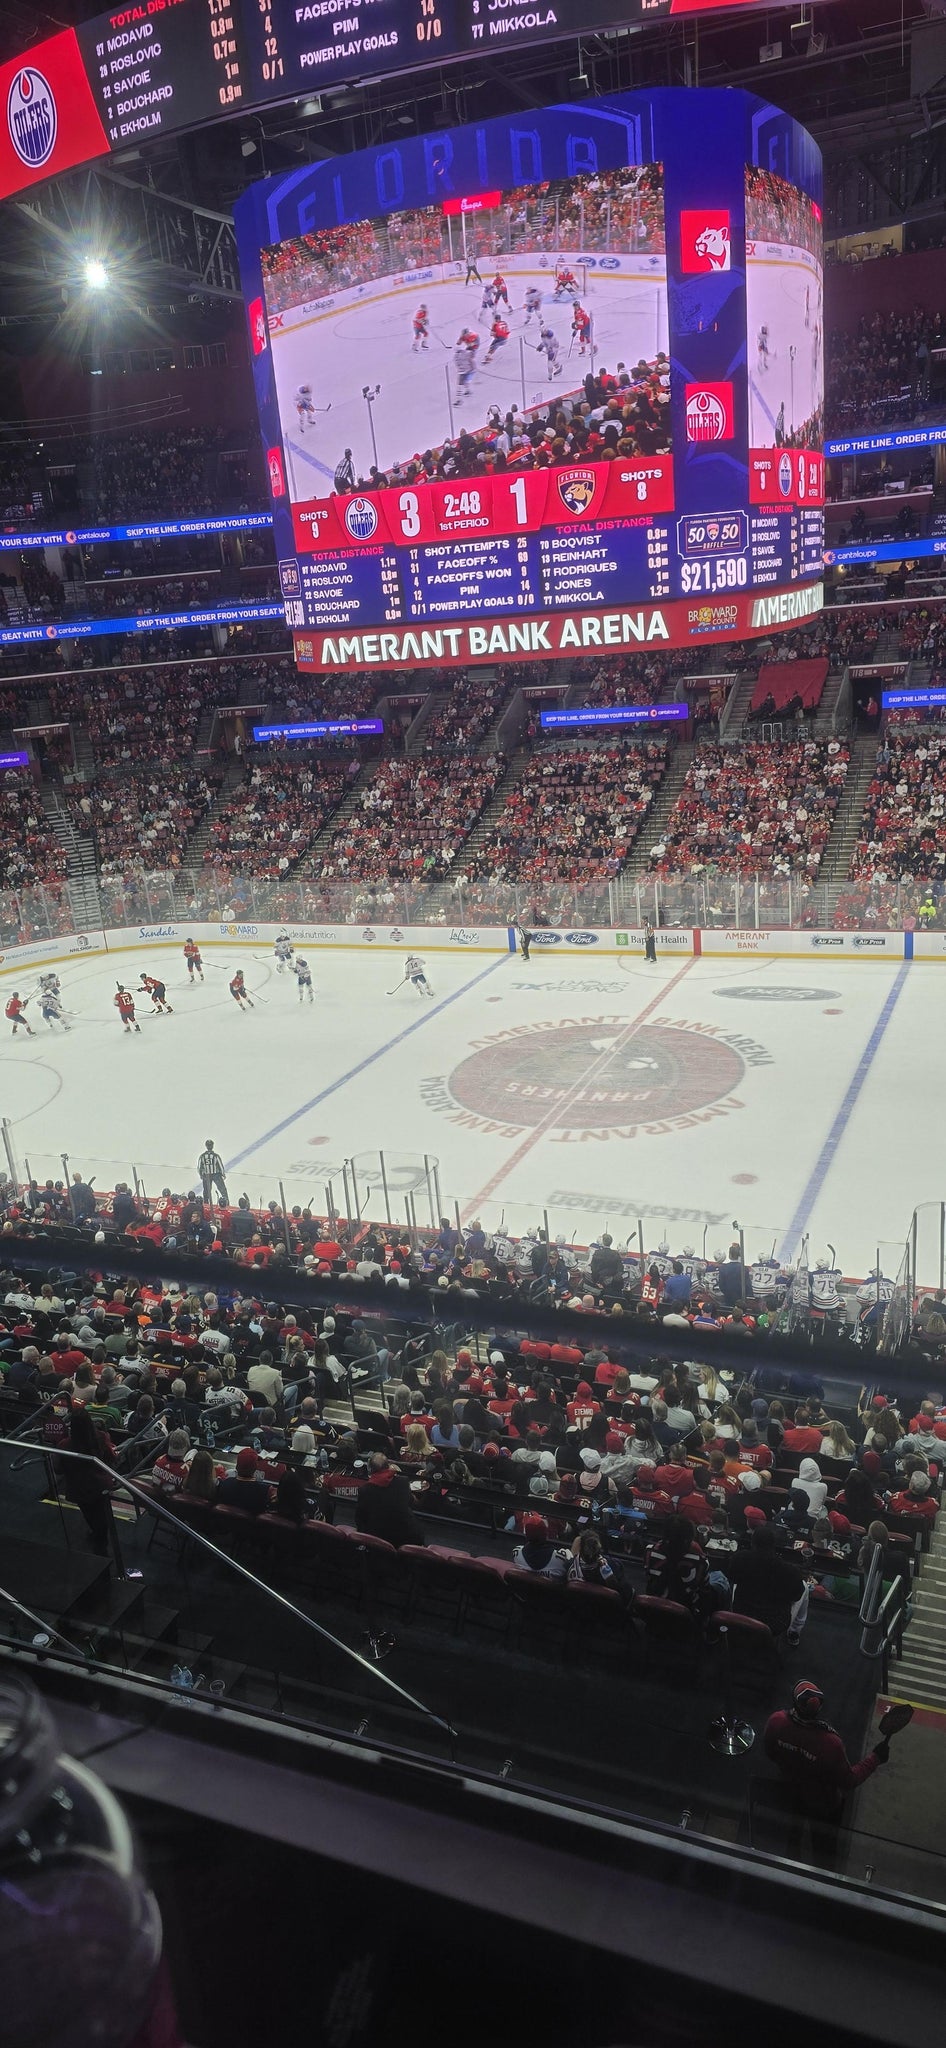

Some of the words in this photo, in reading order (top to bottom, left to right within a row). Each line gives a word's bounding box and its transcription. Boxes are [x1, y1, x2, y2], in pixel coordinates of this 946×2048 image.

[110, 6, 146, 29] TOTAL
[264, 15, 272, 33] 4
[333, 17, 359, 36] PIM
[472, 23, 484, 39] 77
[489, 9, 558, 35] MIKKOLA
[107, 23, 153, 52] MCDAVID
[416, 19, 442, 41] 0/0
[264, 37, 278, 56] 12
[300, 47, 335, 68] POWER
[335, 40, 362, 59] PLAY
[363, 31, 399, 51] GOALS
[110, 43, 162, 74] ROSLOVIC
[262, 58, 284, 80] 0/1
[103, 85, 111, 99] 22
[114, 70, 151, 94] SAVOIE
[108, 107, 113, 119] 2
[117, 85, 173, 116] BOUCHARD
[110, 127, 118, 140] 14
[120, 112, 161, 137] EKHOLM
[688, 412, 721, 429] OILERS
[829, 443, 851, 454] SKIP
[851, 441, 870, 451] THE
[871, 438, 894, 449] LINE.
[895, 434, 927, 446] ORDER
[753, 461, 772, 470] SHOTS
[560, 470, 593, 483] FLORIDA
[620, 469, 663, 482] SHOTS
[798, 454, 805, 498] 3
[636, 481, 647, 500] 8
[443, 490, 481, 517] 2:48
[509, 477, 528, 525] 1
[300, 510, 328, 522] SHOTS
[350, 510, 374, 536] OILERS
[399, 491, 421, 537] 3
[126, 527, 143, 537] SKIP
[143, 526, 158, 536] THE
[159, 525, 180, 535] LINE.
[180, 522, 205, 532] ORDER
[206, 520, 227, 530] FROM
[227, 518, 248, 529] YOUR
[248, 517, 266, 527] SEAT
[311, 521, 319, 538] 9
[439, 522, 452, 531] 1st
[454, 518, 489, 530] PERIOD
[555, 522, 594, 534] TOTAL
[596, 516, 654, 531] DISTANCE
[688, 527, 705, 543] 50
[721, 523, 739, 540] 50
[0, 537, 22, 547] YOUR
[22, 536, 43, 546] SEAT
[43, 535, 62, 545] WITH
[78, 531, 110, 541] cantaloupe
[410, 549, 418, 559] 17
[424, 546, 451, 557] SHOT
[453, 540, 510, 554] ATTEMPTS
[517, 537, 527, 548] 25
[540, 540, 549, 550] 70
[552, 535, 602, 549] BOQVIST
[312, 552, 339, 561] TOTAL
[341, 546, 384, 558] DISTANCE
[552, 549, 608, 562] REINHART
[837, 549, 877, 560] cantaloupe
[310, 562, 347, 574] MCDAVID
[410, 563, 419, 574] 31
[437, 557, 487, 569] FACEOFF
[489, 555, 498, 564] %
[542, 568, 551, 577] 17
[553, 562, 617, 577] RODRIGUES
[312, 575, 353, 587] ROSLOVIC
[414, 577, 419, 587] 4
[427, 571, 484, 584] FACEOFFS
[485, 568, 512, 579] WON
[681, 557, 747, 593] $21,590
[313, 589, 343, 599] SAVOIE
[413, 590, 422, 601] 12
[460, 585, 479, 595] PIM
[520, 580, 530, 591] 14
[544, 582, 550, 591] 3
[554, 579, 592, 590] JONES
[308, 604, 312, 612] 2
[315, 600, 360, 612] BOUCHARD
[411, 604, 426, 615] 0/1
[429, 601, 459, 612] POWER
[460, 599, 482, 609] PLAY
[484, 596, 514, 607] GOALS
[517, 594, 534, 605] 0/0
[543, 596, 552, 605] 77
[555, 591, 604, 604] MIKKOLA
[136, 619, 153, 628] SKIP
[153, 617, 168, 627] THE
[169, 616, 190, 626] LINE.
[191, 613, 216, 622] ORDER
[217, 611, 238, 620] FROM
[238, 609, 259, 618] YOUR
[259, 607, 277, 616] SEAT
[688, 605, 738, 622] BROWARD
[754, 590, 812, 627] AMERANT
[316, 613, 349, 624] EKHOLM
[712, 616, 737, 625] COUNTY
[2, 632, 22, 640] SEAT
[22, 630, 43, 639] WITH
[58, 626, 91, 636] cantaloupe
[321, 627, 464, 665] AMERANT
[469, 620, 553, 656] BANK
[559, 610, 670, 649] ARENA
[690, 623, 736, 634] FLORIDA
[139, 927, 178, 938] Sandals
[220, 925, 258, 937] BROWARD
[536, 934, 556, 944] Ford
[571, 934, 592, 944] Ford
[660, 935, 688, 944] Health
[725, 932, 770, 940] AMERANT
[121, 996, 131, 1006] 13
[467, 1015, 632, 1050] AMERANT
[650, 1016, 729, 1036] BANK
[718, 1033, 776, 1068] ARENA
[418, 1074, 457, 1112] ARENA
[504, 1081, 652, 1102] PANTHERS
[444, 1102, 528, 1140] BANK
[549, 1096, 748, 1144] AMERANT
[547, 1192, 730, 1224] AutoNation
[642, 1286, 657, 1300] 63
[817, 1280, 835, 1294] 75
[45, 1423, 63, 1431] STOP
